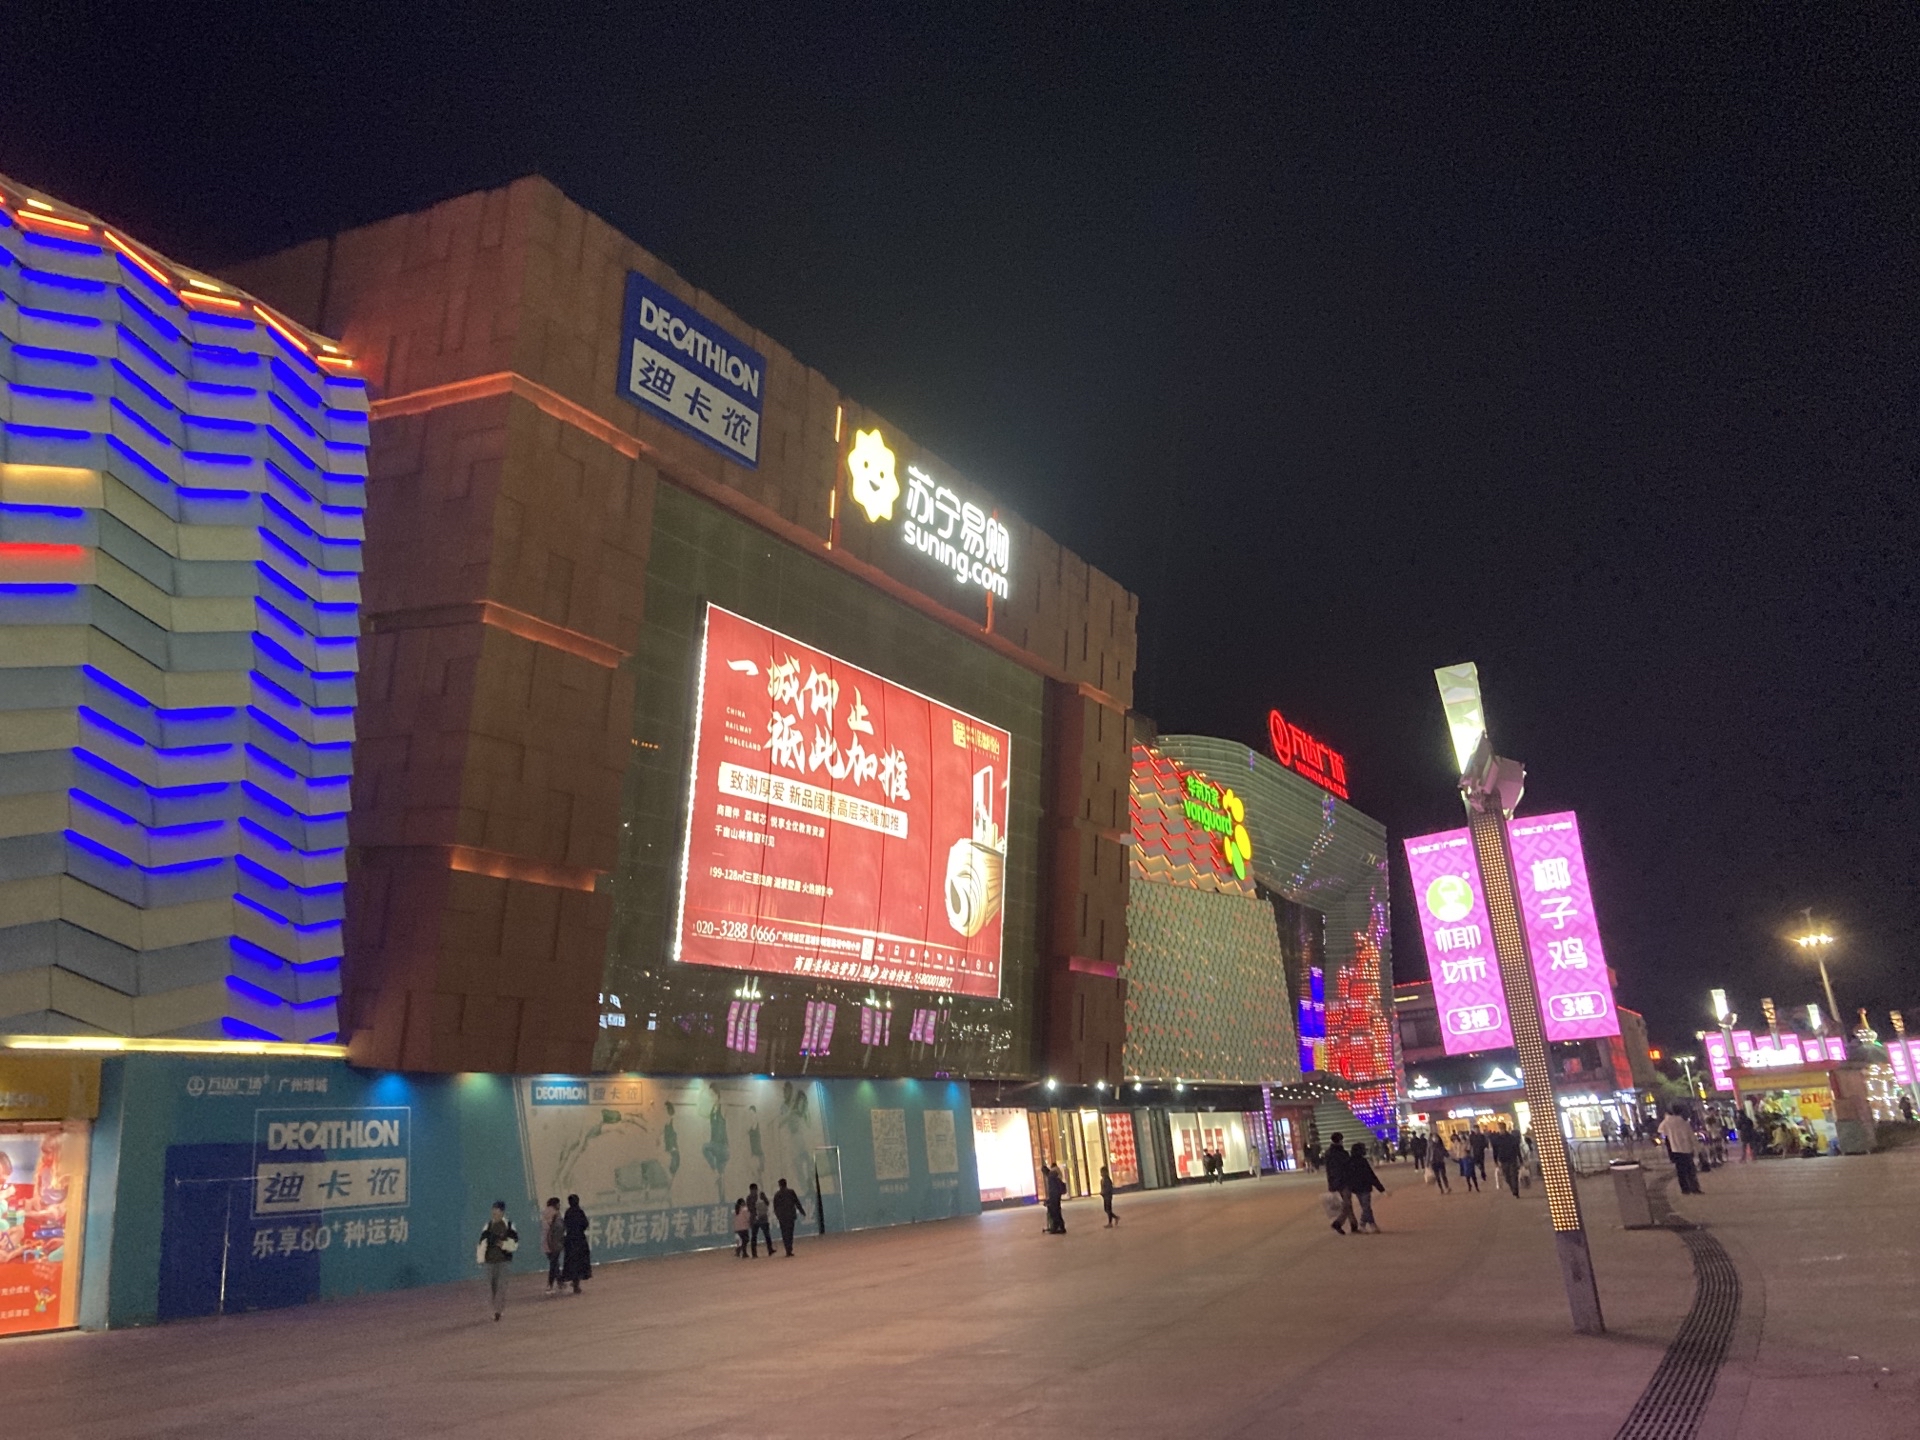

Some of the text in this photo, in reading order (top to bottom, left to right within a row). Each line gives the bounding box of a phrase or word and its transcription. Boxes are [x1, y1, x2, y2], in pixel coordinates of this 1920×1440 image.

[640, 296, 760, 399] DECATHLON
[637, 355, 752, 448] 迪卡侬
[905, 464, 1010, 575] 苏宁易购
[904, 519, 1009, 600] suning.com
[725, 720, 752, 735] RAILWAY
[726, 705, 746, 719] CHINA
[724, 734, 762, 752] NOBLELAND
[730, 769, 785, 802] 致谢厚爱
[1530, 856, 1589, 971] 椰子鸡
[696, 919, 748, 940] 020-3288
[750, 925, 776, 943] 0666
[536, 1086, 587, 1100] DECATHLON
[267, 1120, 400, 1151] DECATHLON
[263, 1167, 401, 1204] 迪卡侬
